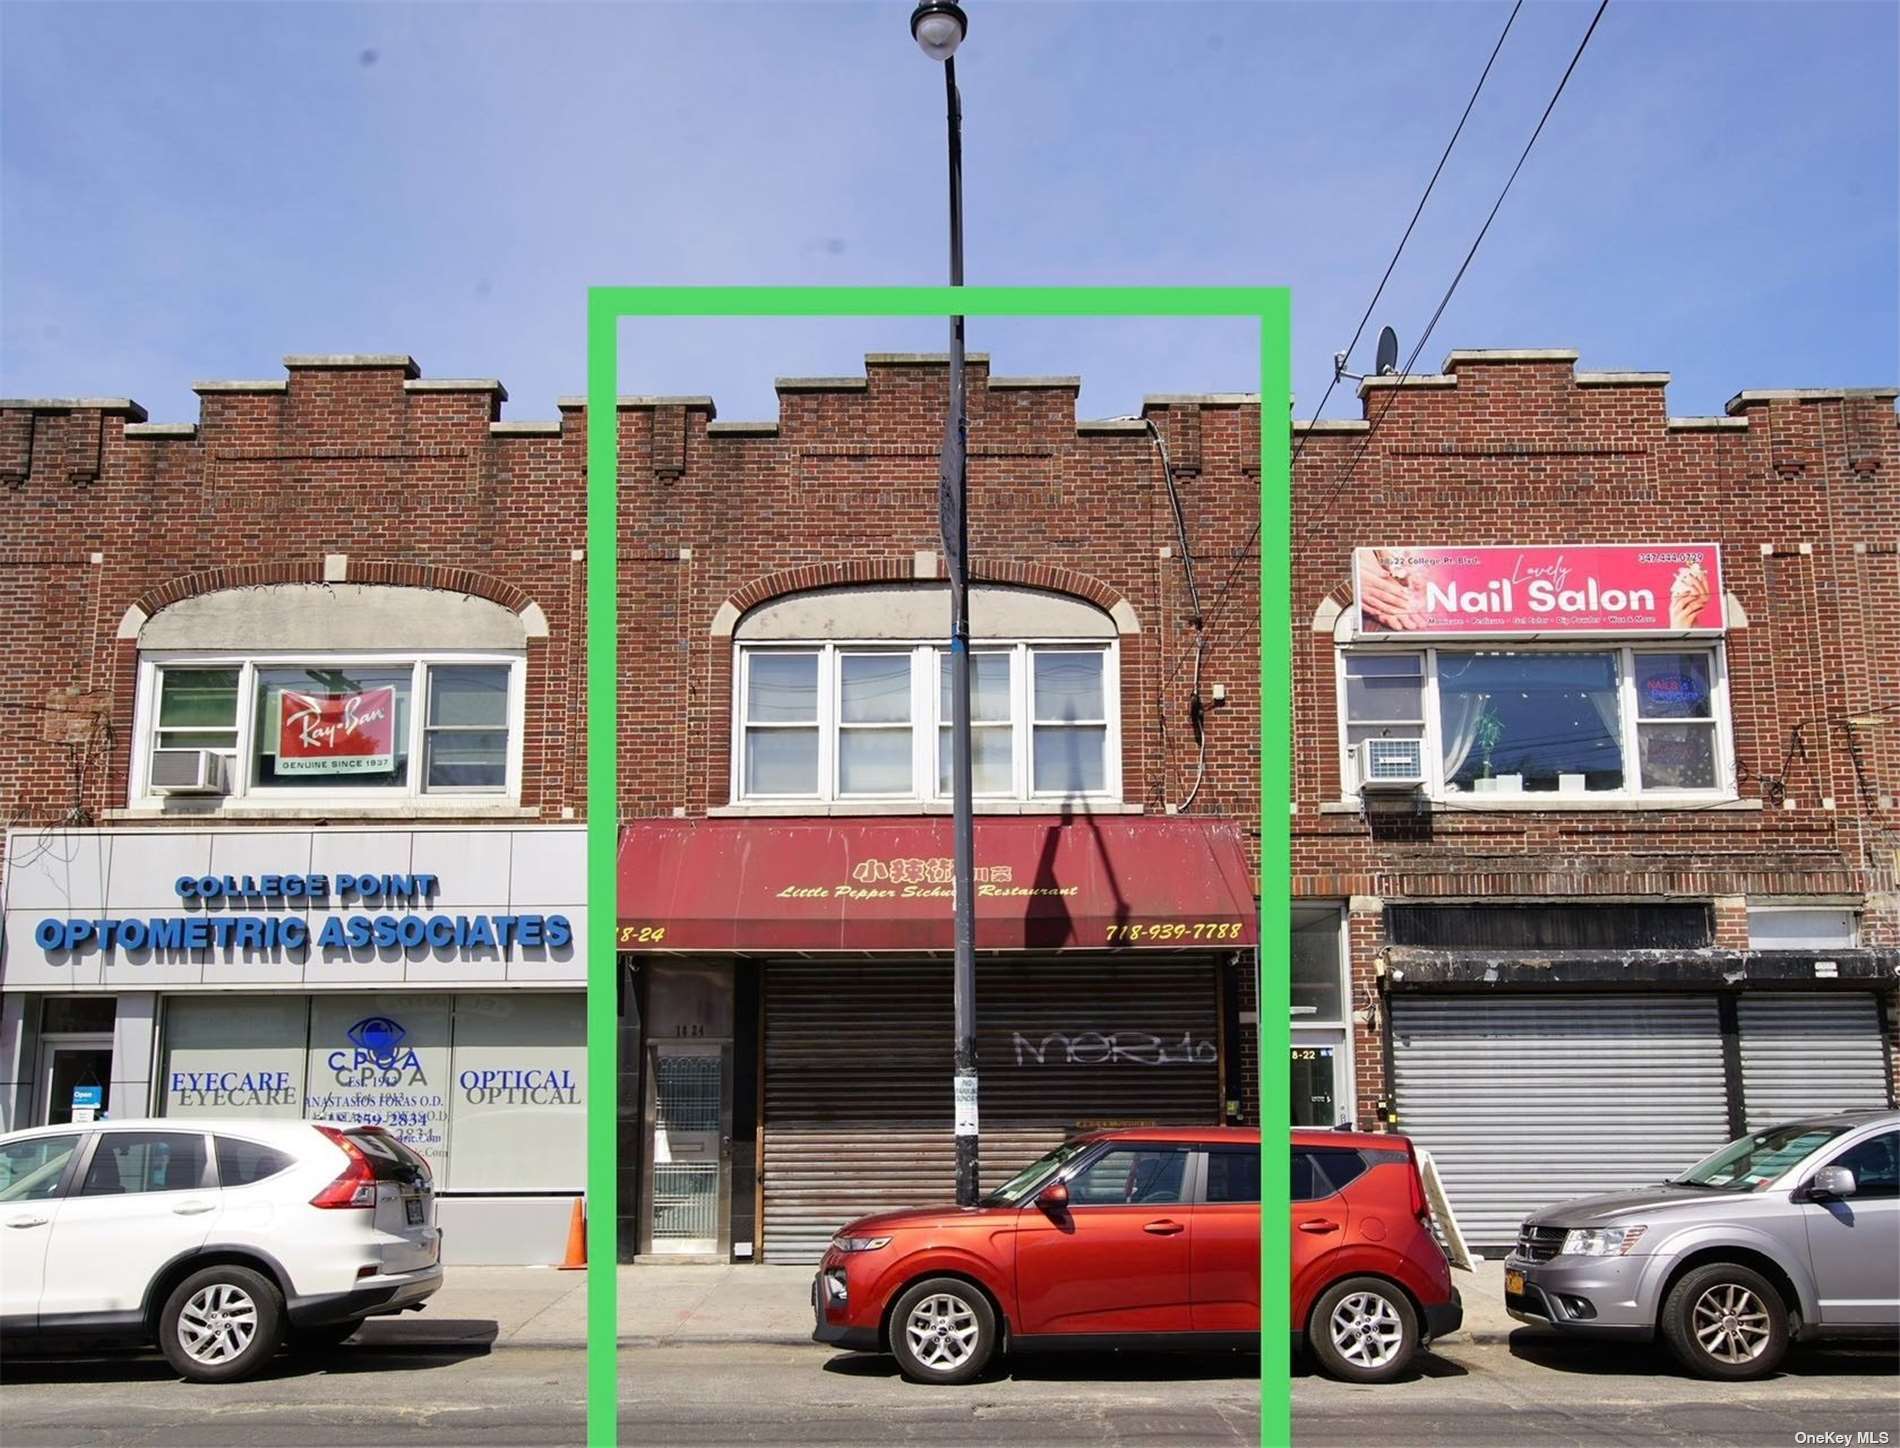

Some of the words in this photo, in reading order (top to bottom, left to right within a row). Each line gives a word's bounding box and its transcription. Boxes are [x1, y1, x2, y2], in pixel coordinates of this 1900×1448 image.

[1512, 554, 1572, 591] Lovely
[1426, 578, 1513, 613] Nail
[1527, 578, 1655, 613] Salon
[286, 695, 385, 748] Ray-Ban
[282, 760, 328, 769] GENUINE
[331, 760, 363, 768] SINCE
[174, 874, 328, 897] COLLEGE
[334, 874, 440, 897] POINT
[776, 885, 829, 897] Little
[834, 885, 896, 900] Pepper
[977, 884, 1079, 897] Restaurant
[35, 917, 309, 951] OPTOMETRIC
[318, 915, 573, 948] ASSOCIATES
[1106, 922, 1242, 941] 718-939-7788
[328, 1049, 422, 1071] CPOA
[171, 1071, 289, 1092] EYECARE
[460, 1070, 576, 1090] OPTICAL
